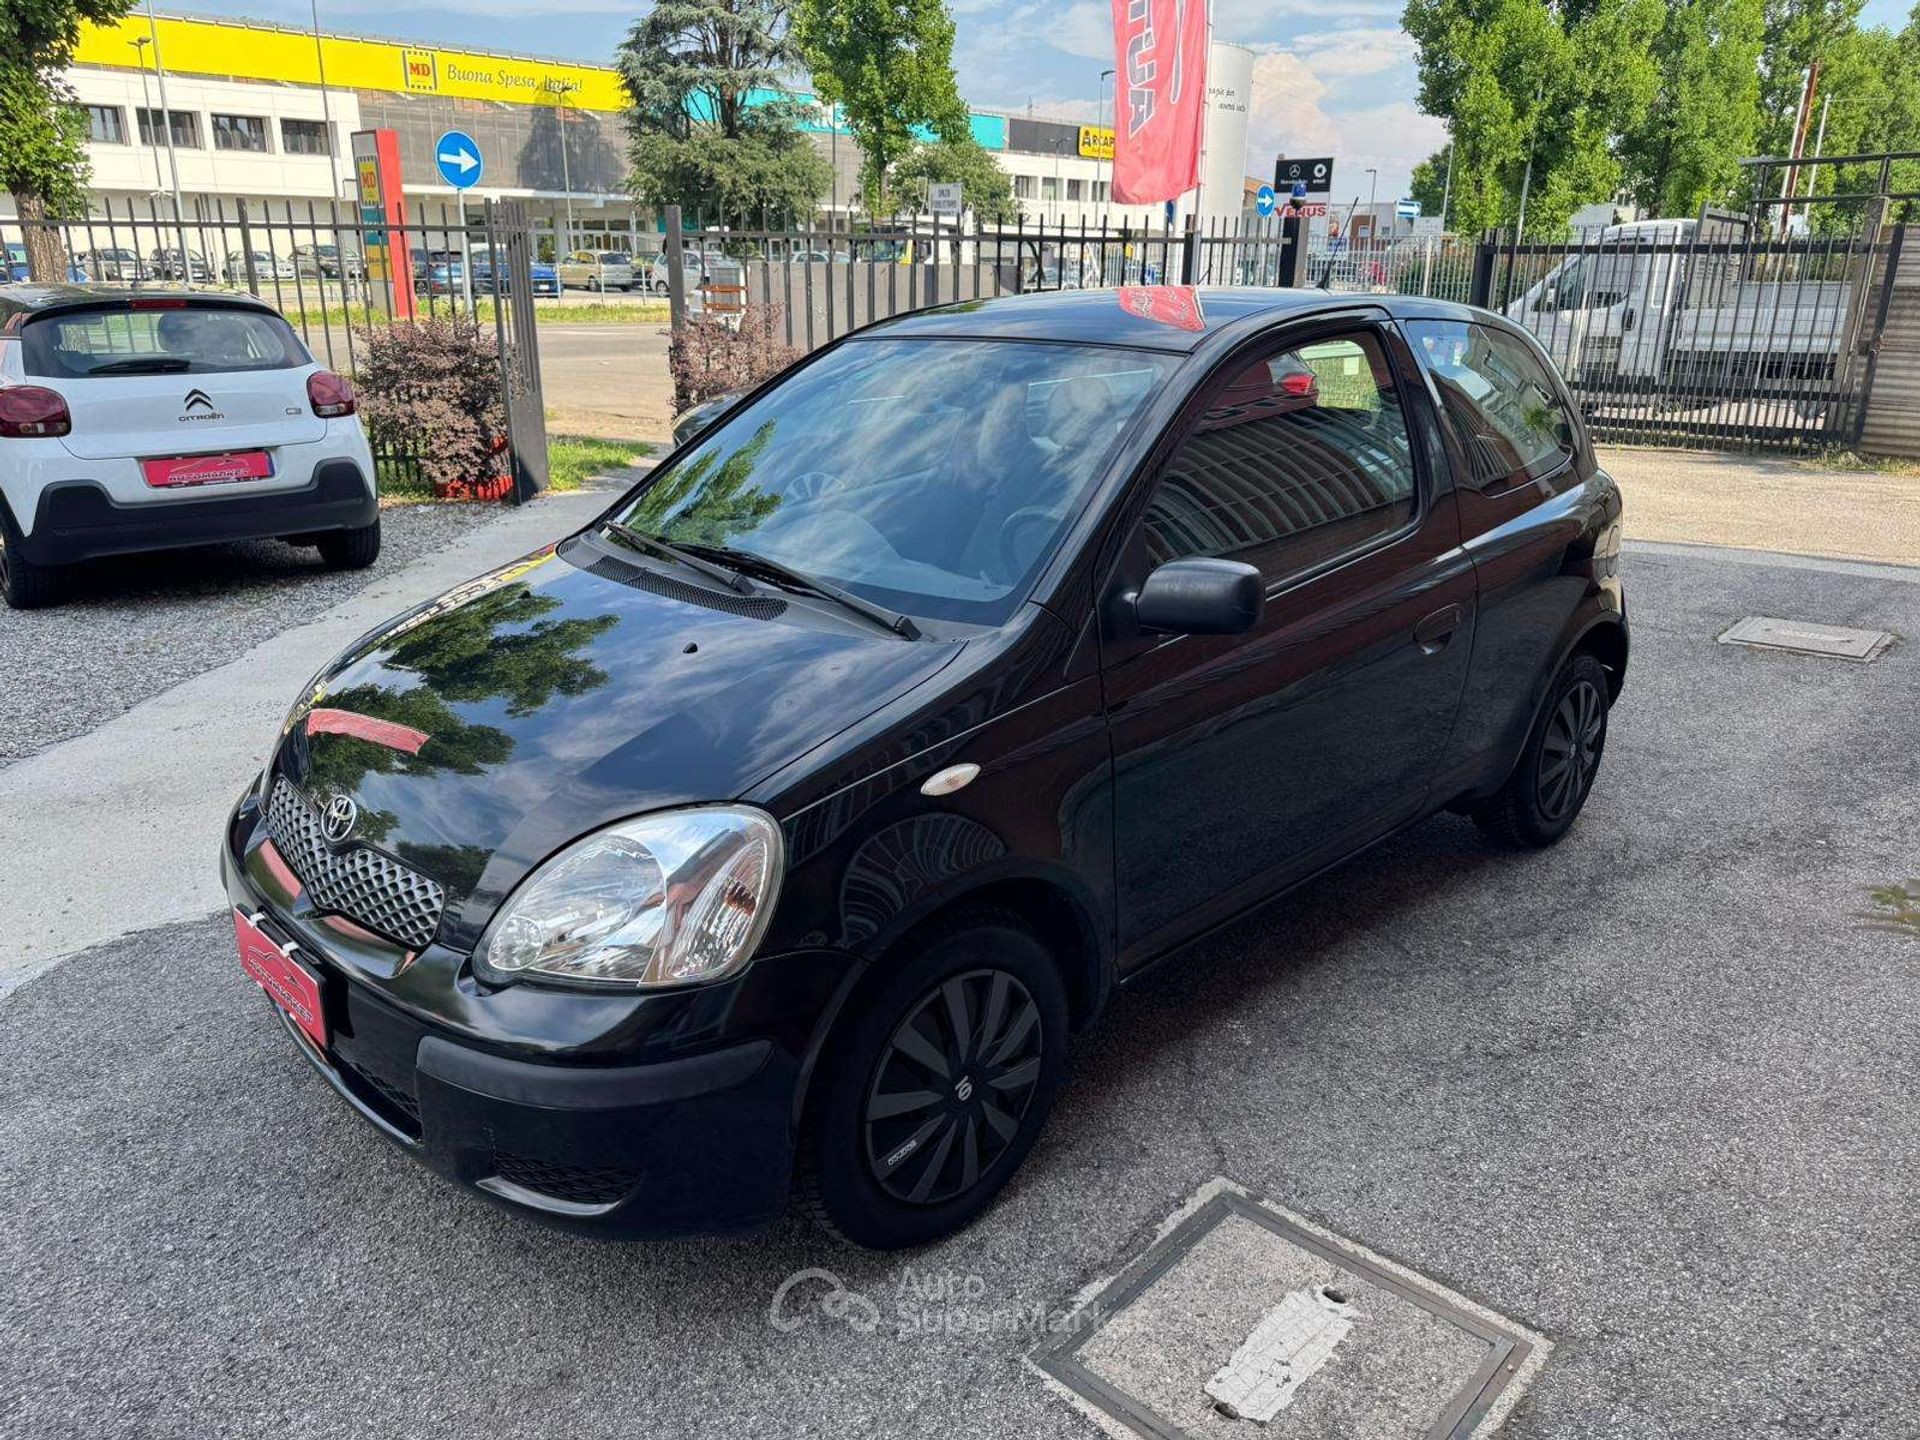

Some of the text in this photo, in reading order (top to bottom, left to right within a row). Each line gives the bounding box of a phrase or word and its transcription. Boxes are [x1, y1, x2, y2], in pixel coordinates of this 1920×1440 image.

[408, 62, 431, 77] MD
[447, 64, 583, 93] Buona Spesa, Italia!
[361, 171, 377, 189] MD
